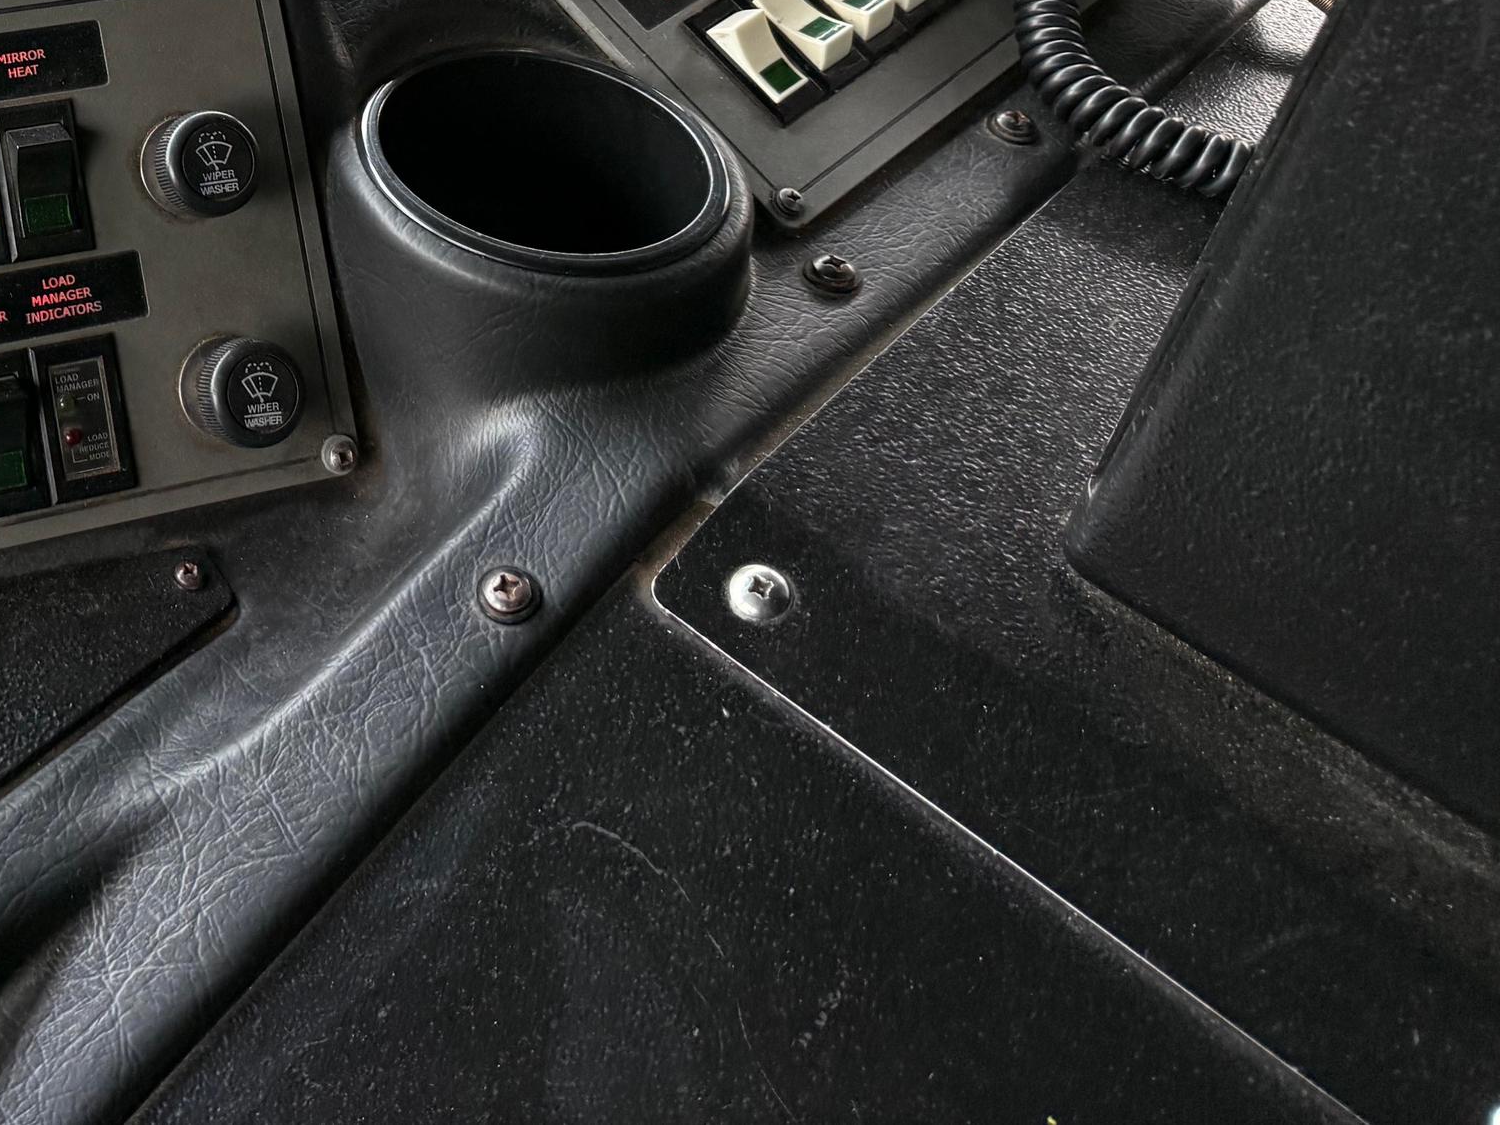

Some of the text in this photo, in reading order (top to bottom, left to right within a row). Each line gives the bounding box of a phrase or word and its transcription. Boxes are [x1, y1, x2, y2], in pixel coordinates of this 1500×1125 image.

[8, 64, 40, 79] HEAT
[202, 169, 235, 181] WIPER
[200, 182, 240, 196] WASHER
[41, 274, 76, 290] LOAD
[31, 286, 93, 307] MANAGER
[25, 300, 103, 325] INDICATORS
[55, 373, 79, 385] LOAD
[56, 378, 100, 393] MANAGER
[86, 392, 100, 402] ON
[247, 401, 280, 414] WIPER
[244, 415, 283, 428] WASHER
[87, 432, 108, 442] LOAD
